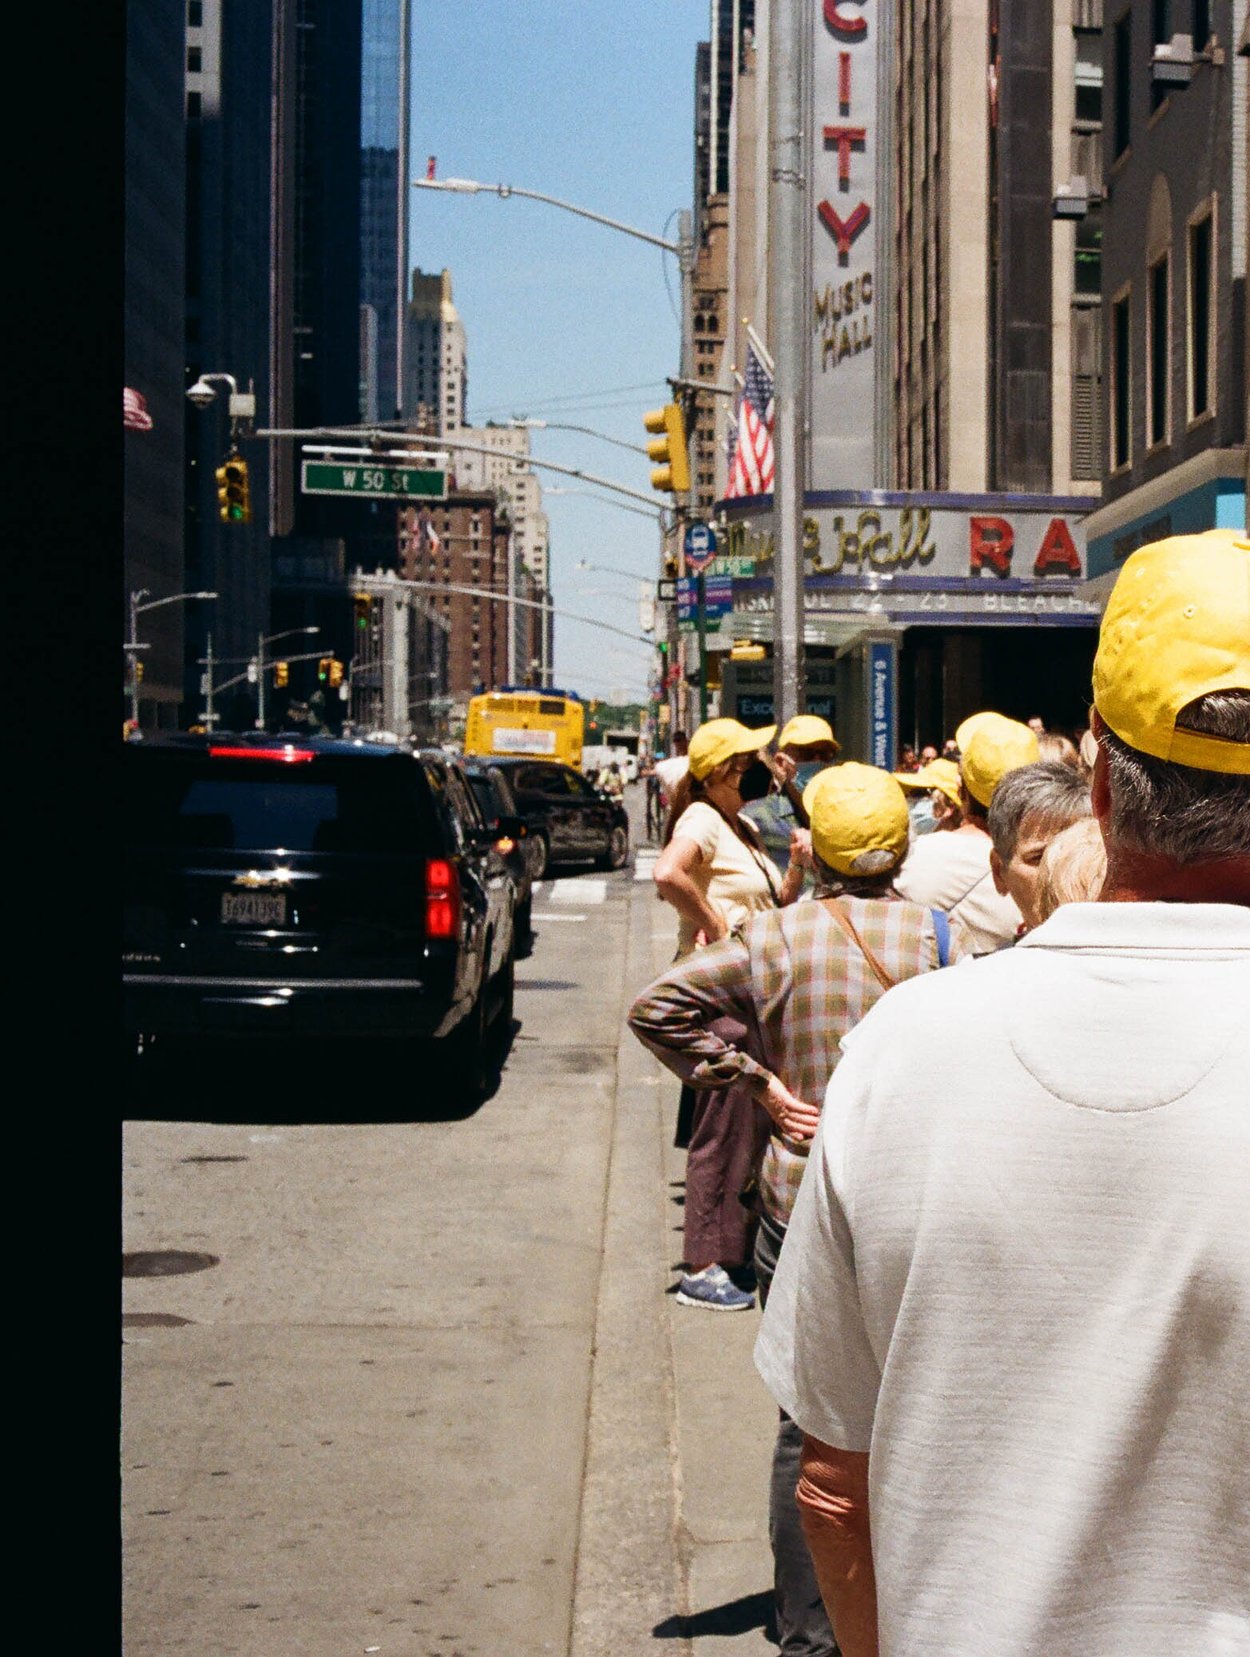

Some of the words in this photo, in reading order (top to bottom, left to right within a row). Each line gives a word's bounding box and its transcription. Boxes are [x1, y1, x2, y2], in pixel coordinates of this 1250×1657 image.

[818, 0, 870, 266] CITY
[814, 271, 872, 332] MUSIC
[821, 314, 872, 373] HALL
[343, 470, 356, 488] W
[363, 471, 385, 490] 50
[391, 473, 409, 491] St
[970, 516, 1081, 578] RA
